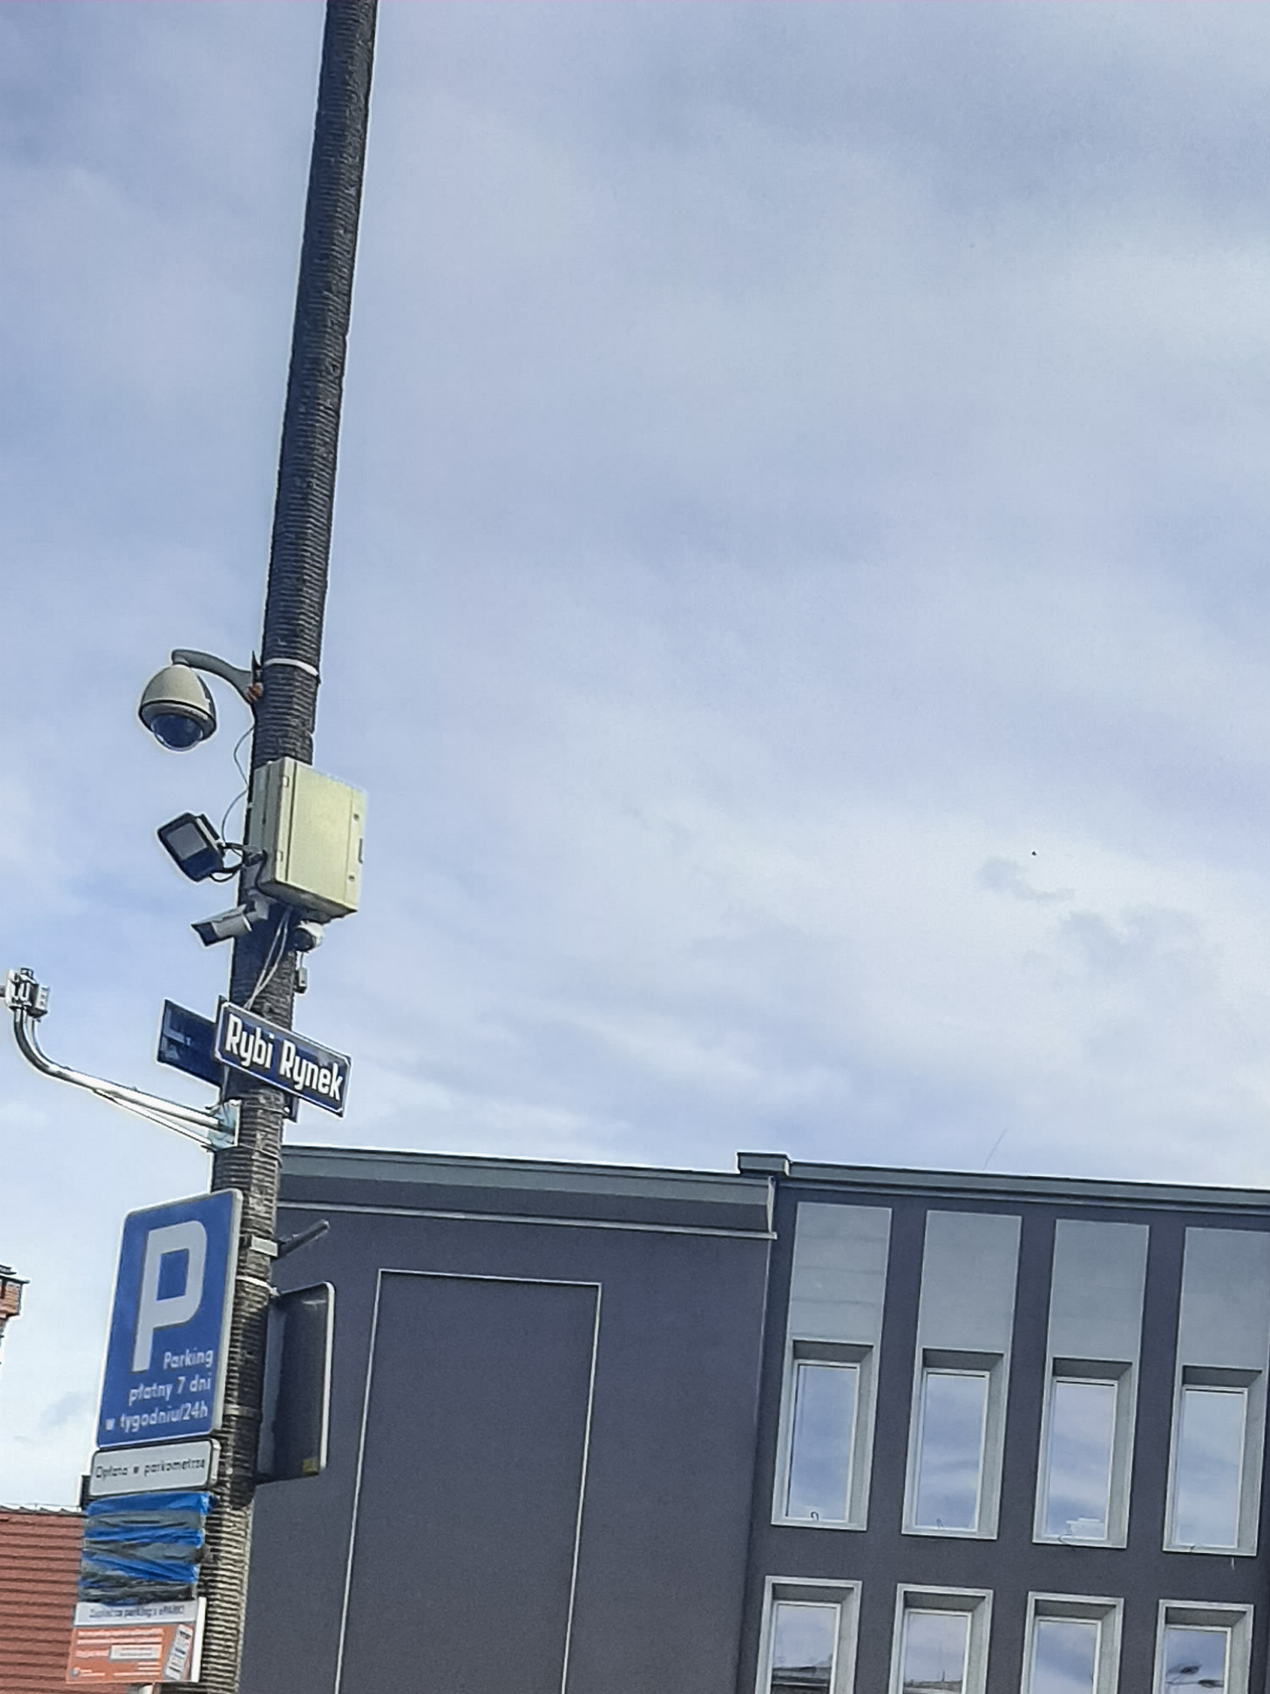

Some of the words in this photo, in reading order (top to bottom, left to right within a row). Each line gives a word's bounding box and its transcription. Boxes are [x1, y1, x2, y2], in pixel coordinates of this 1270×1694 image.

[225, 1013, 275, 1068] Rybi
[279, 1040, 343, 1100] Rynek
[132, 1220, 207, 1372] P
[163, 1348, 213, 1370] Parking
[128, 1383, 173, 1406] płatny
[176, 1376, 186, 1394] 7
[189, 1372, 212, 1392] dni
[105, 1418, 115, 1430] w
[120, 1400, 208, 1433] tygodniu/24h
